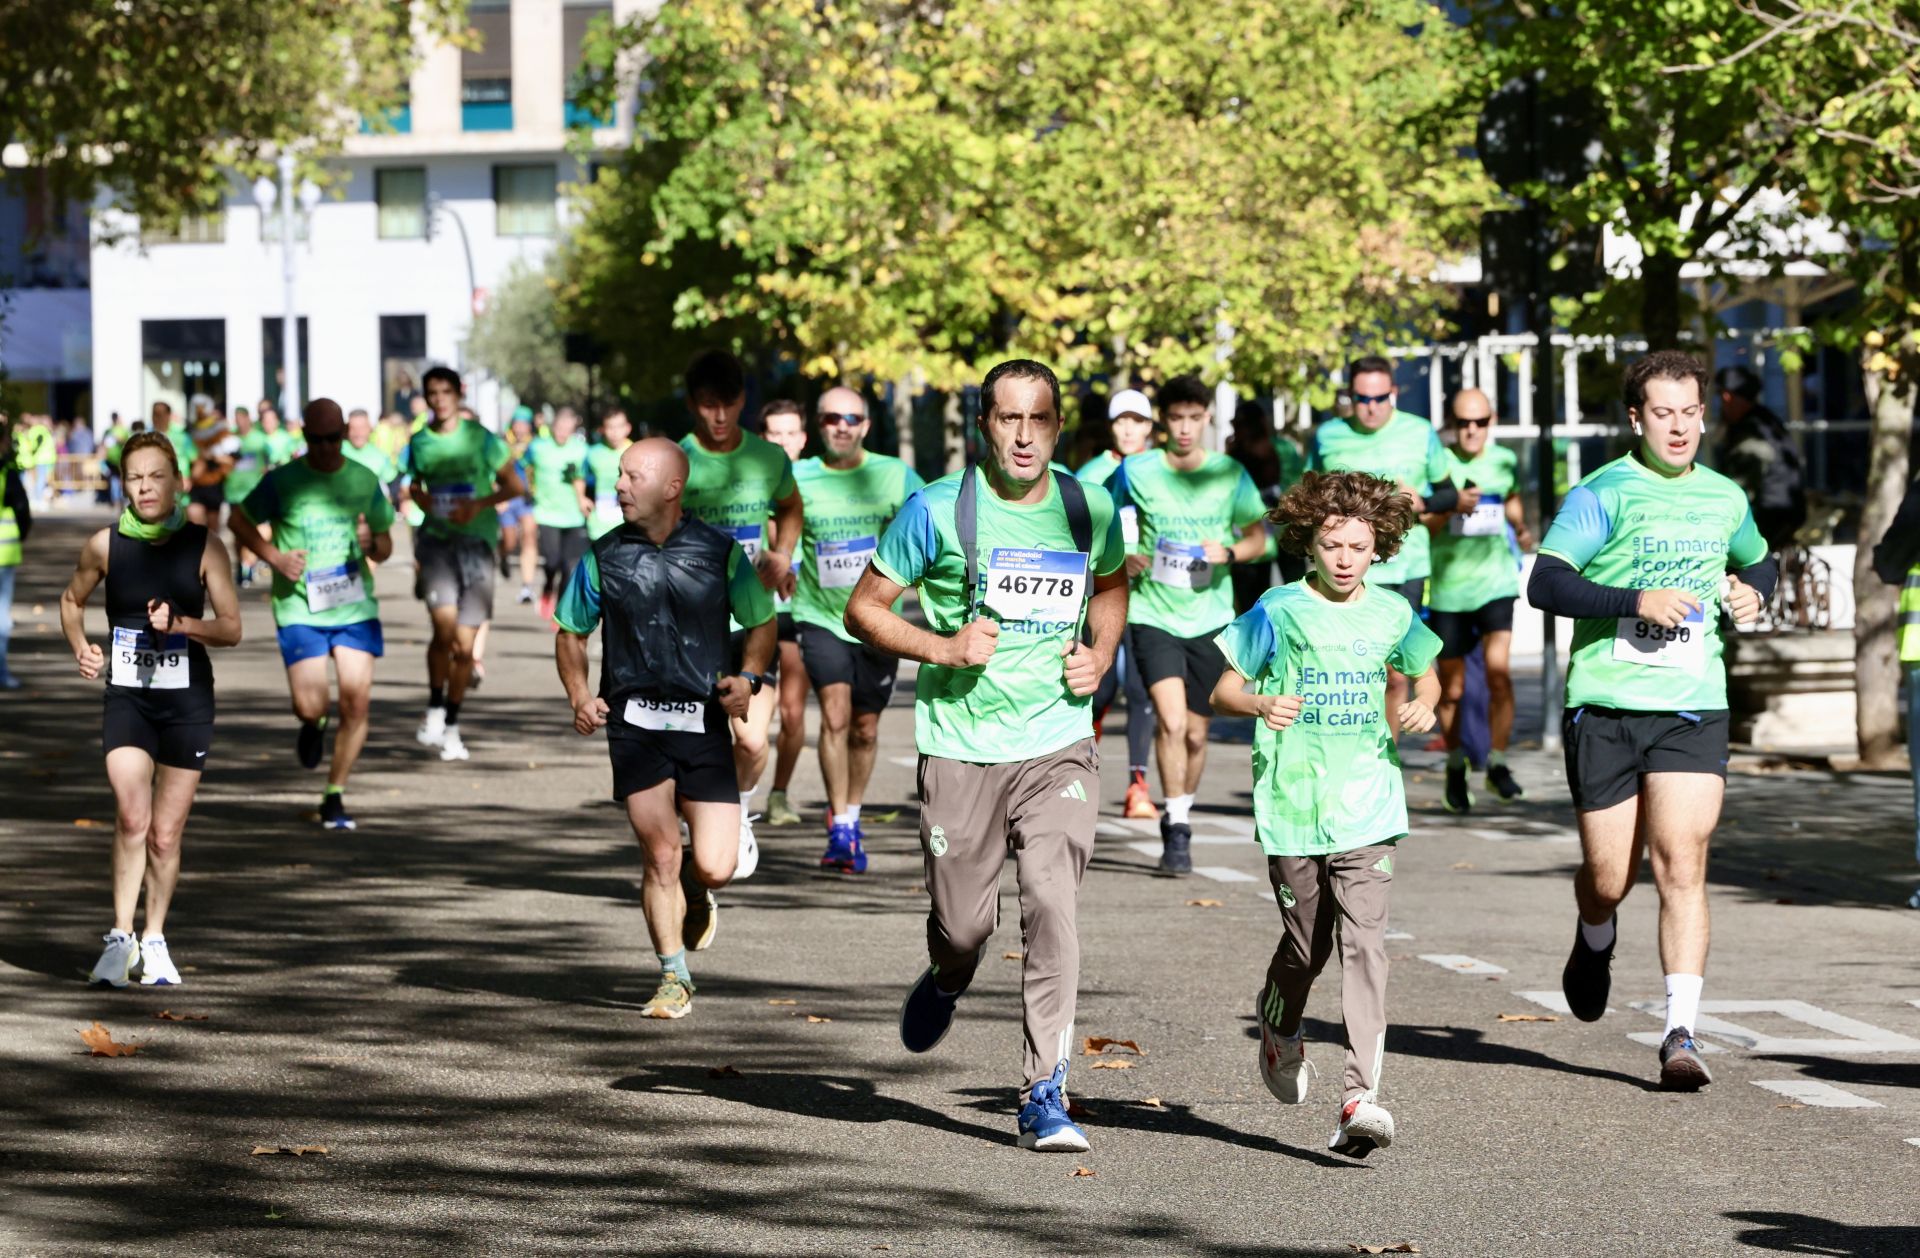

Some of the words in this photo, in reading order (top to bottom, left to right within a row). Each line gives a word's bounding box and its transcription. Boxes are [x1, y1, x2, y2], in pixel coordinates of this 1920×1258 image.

[1643, 536, 1669, 554] En
[1642, 557, 1704, 573] contra
[998, 575, 1074, 597] 46778
[1634, 621, 1690, 643] 9350
[122, 651, 180, 668] 52619
[1303, 667, 1328, 685] En
[1303, 688, 1368, 706] contra
[1303, 709, 1322, 725] el
[1327, 709, 1379, 726] cánce
